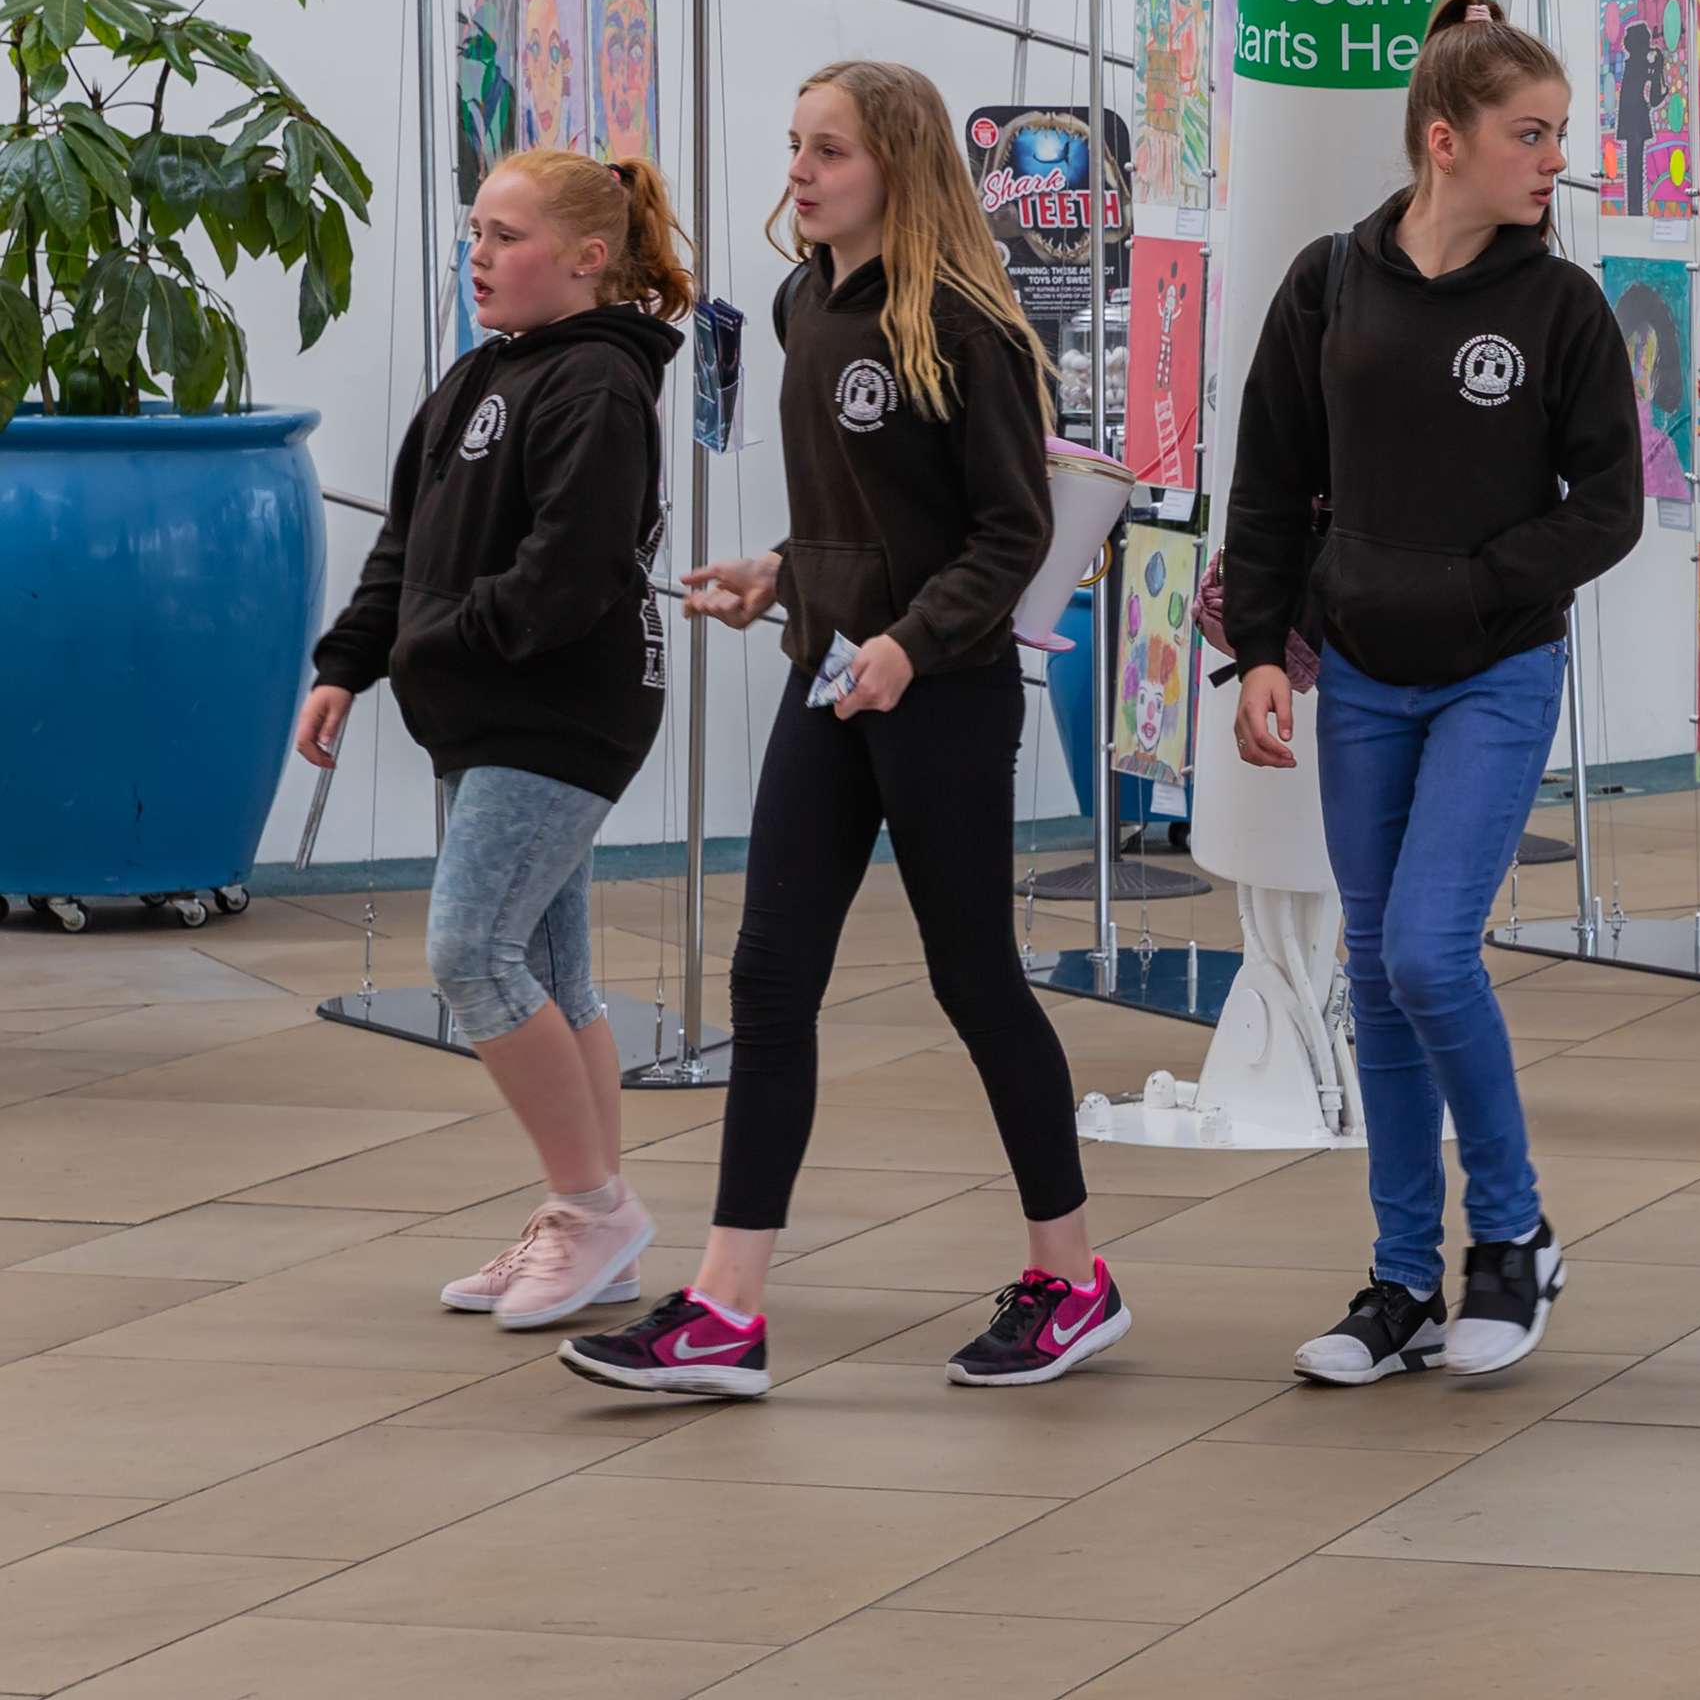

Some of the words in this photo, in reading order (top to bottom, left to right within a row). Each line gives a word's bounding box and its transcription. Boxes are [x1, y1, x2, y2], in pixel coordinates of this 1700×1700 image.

[1341, 23, 1422, 72] He
[983, 167, 1066, 212] Shark
[1019, 190, 1122, 228] TEETH
[1008, 266, 1050, 276] WARNING:
[1051, 266, 1080, 276] THESE
[1028, 276, 1051, 285] TOYS
[1066, 276, 1091, 285] SWEE
[1514, 355, 1526, 386] SCHOOL
[1459, 387, 1492, 407] LEAVERS
[1492, 394, 1511, 406] 2018
